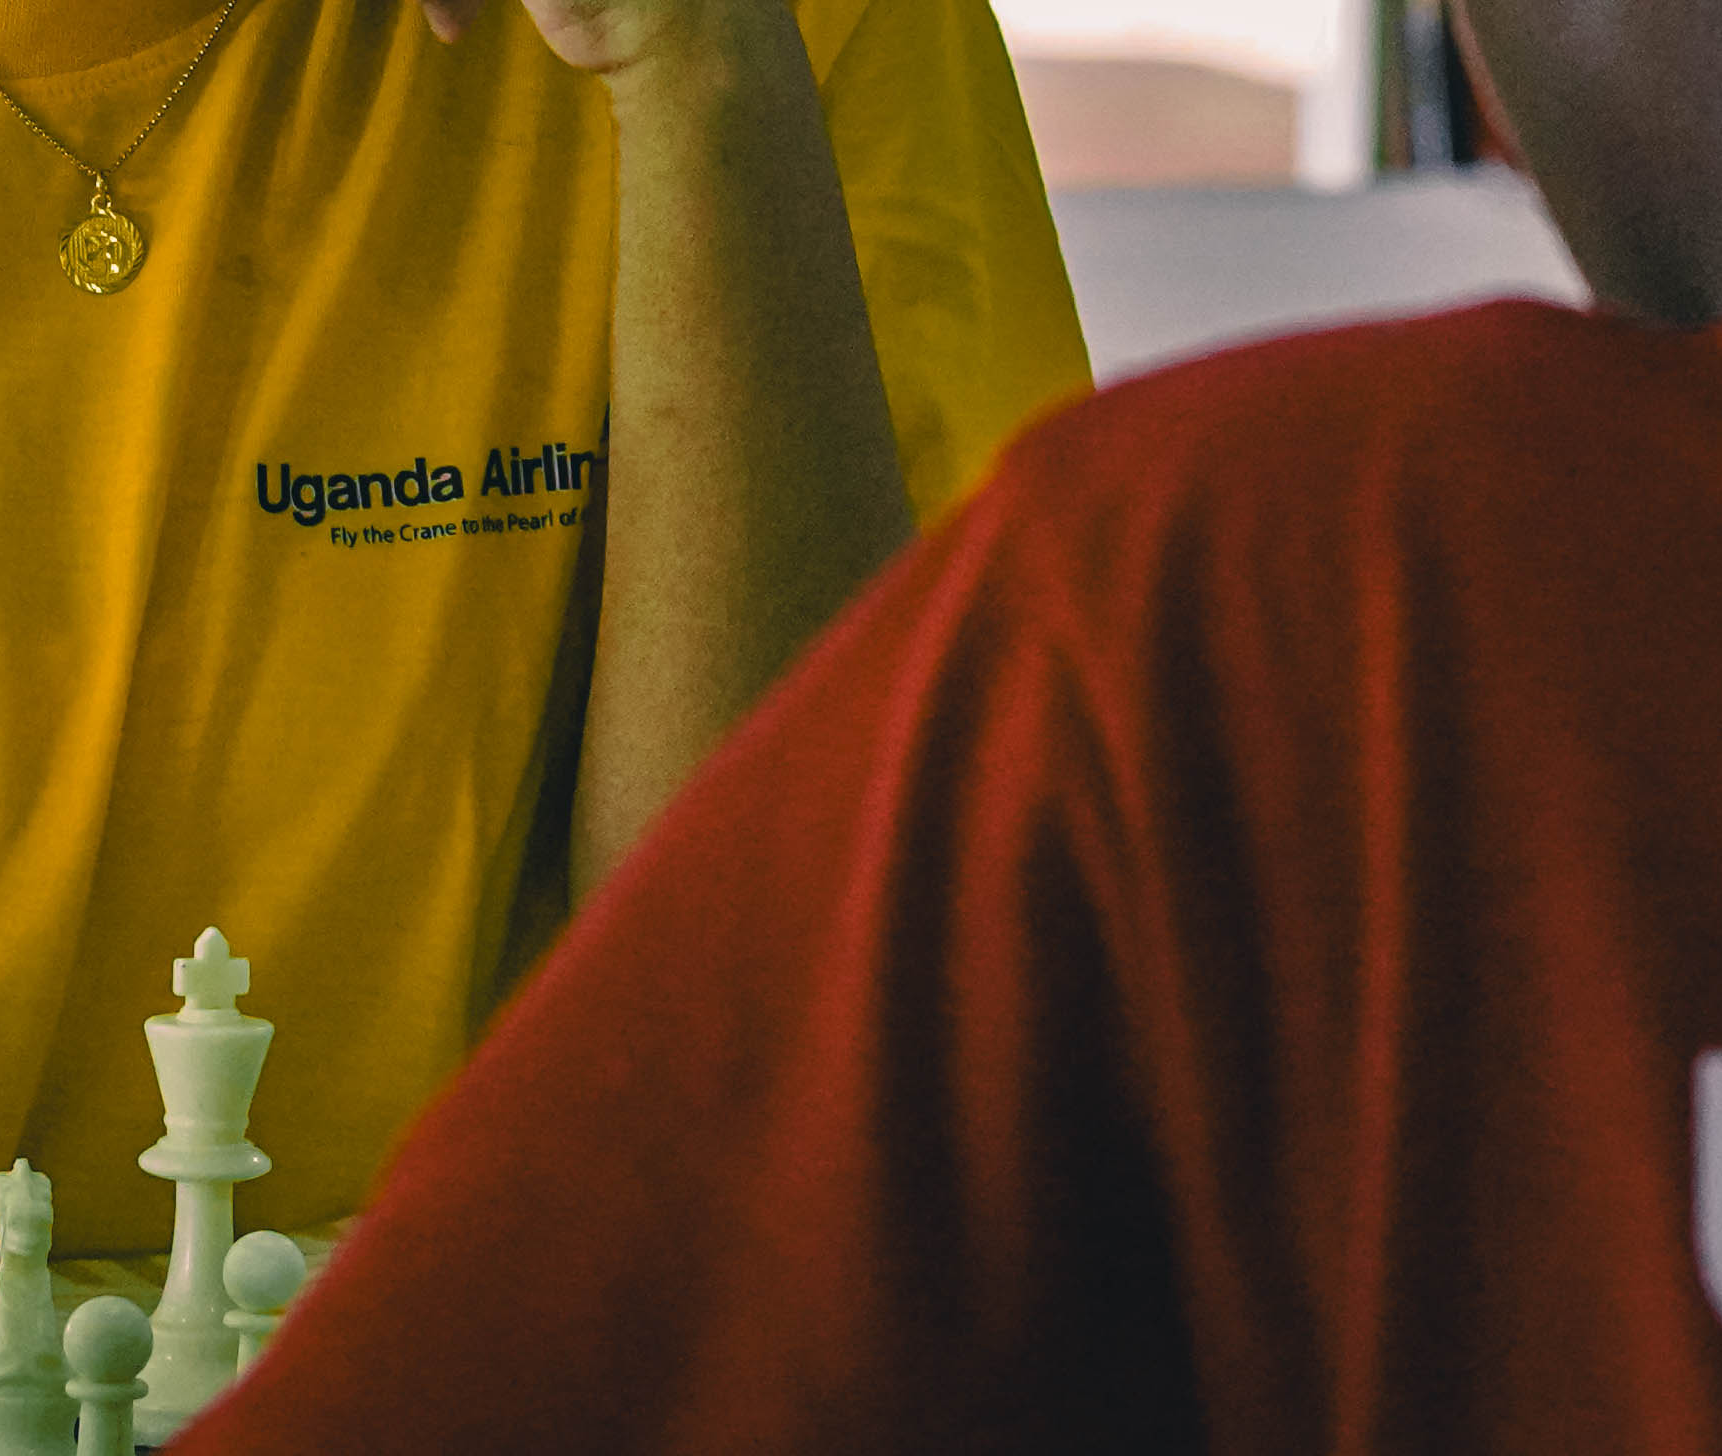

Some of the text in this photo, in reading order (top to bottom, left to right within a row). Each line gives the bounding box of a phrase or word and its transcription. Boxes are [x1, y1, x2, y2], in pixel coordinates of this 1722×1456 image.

[256, 457, 465, 527] Uganda
[330, 506, 578, 549] Fly the Crane to the Pearl of
